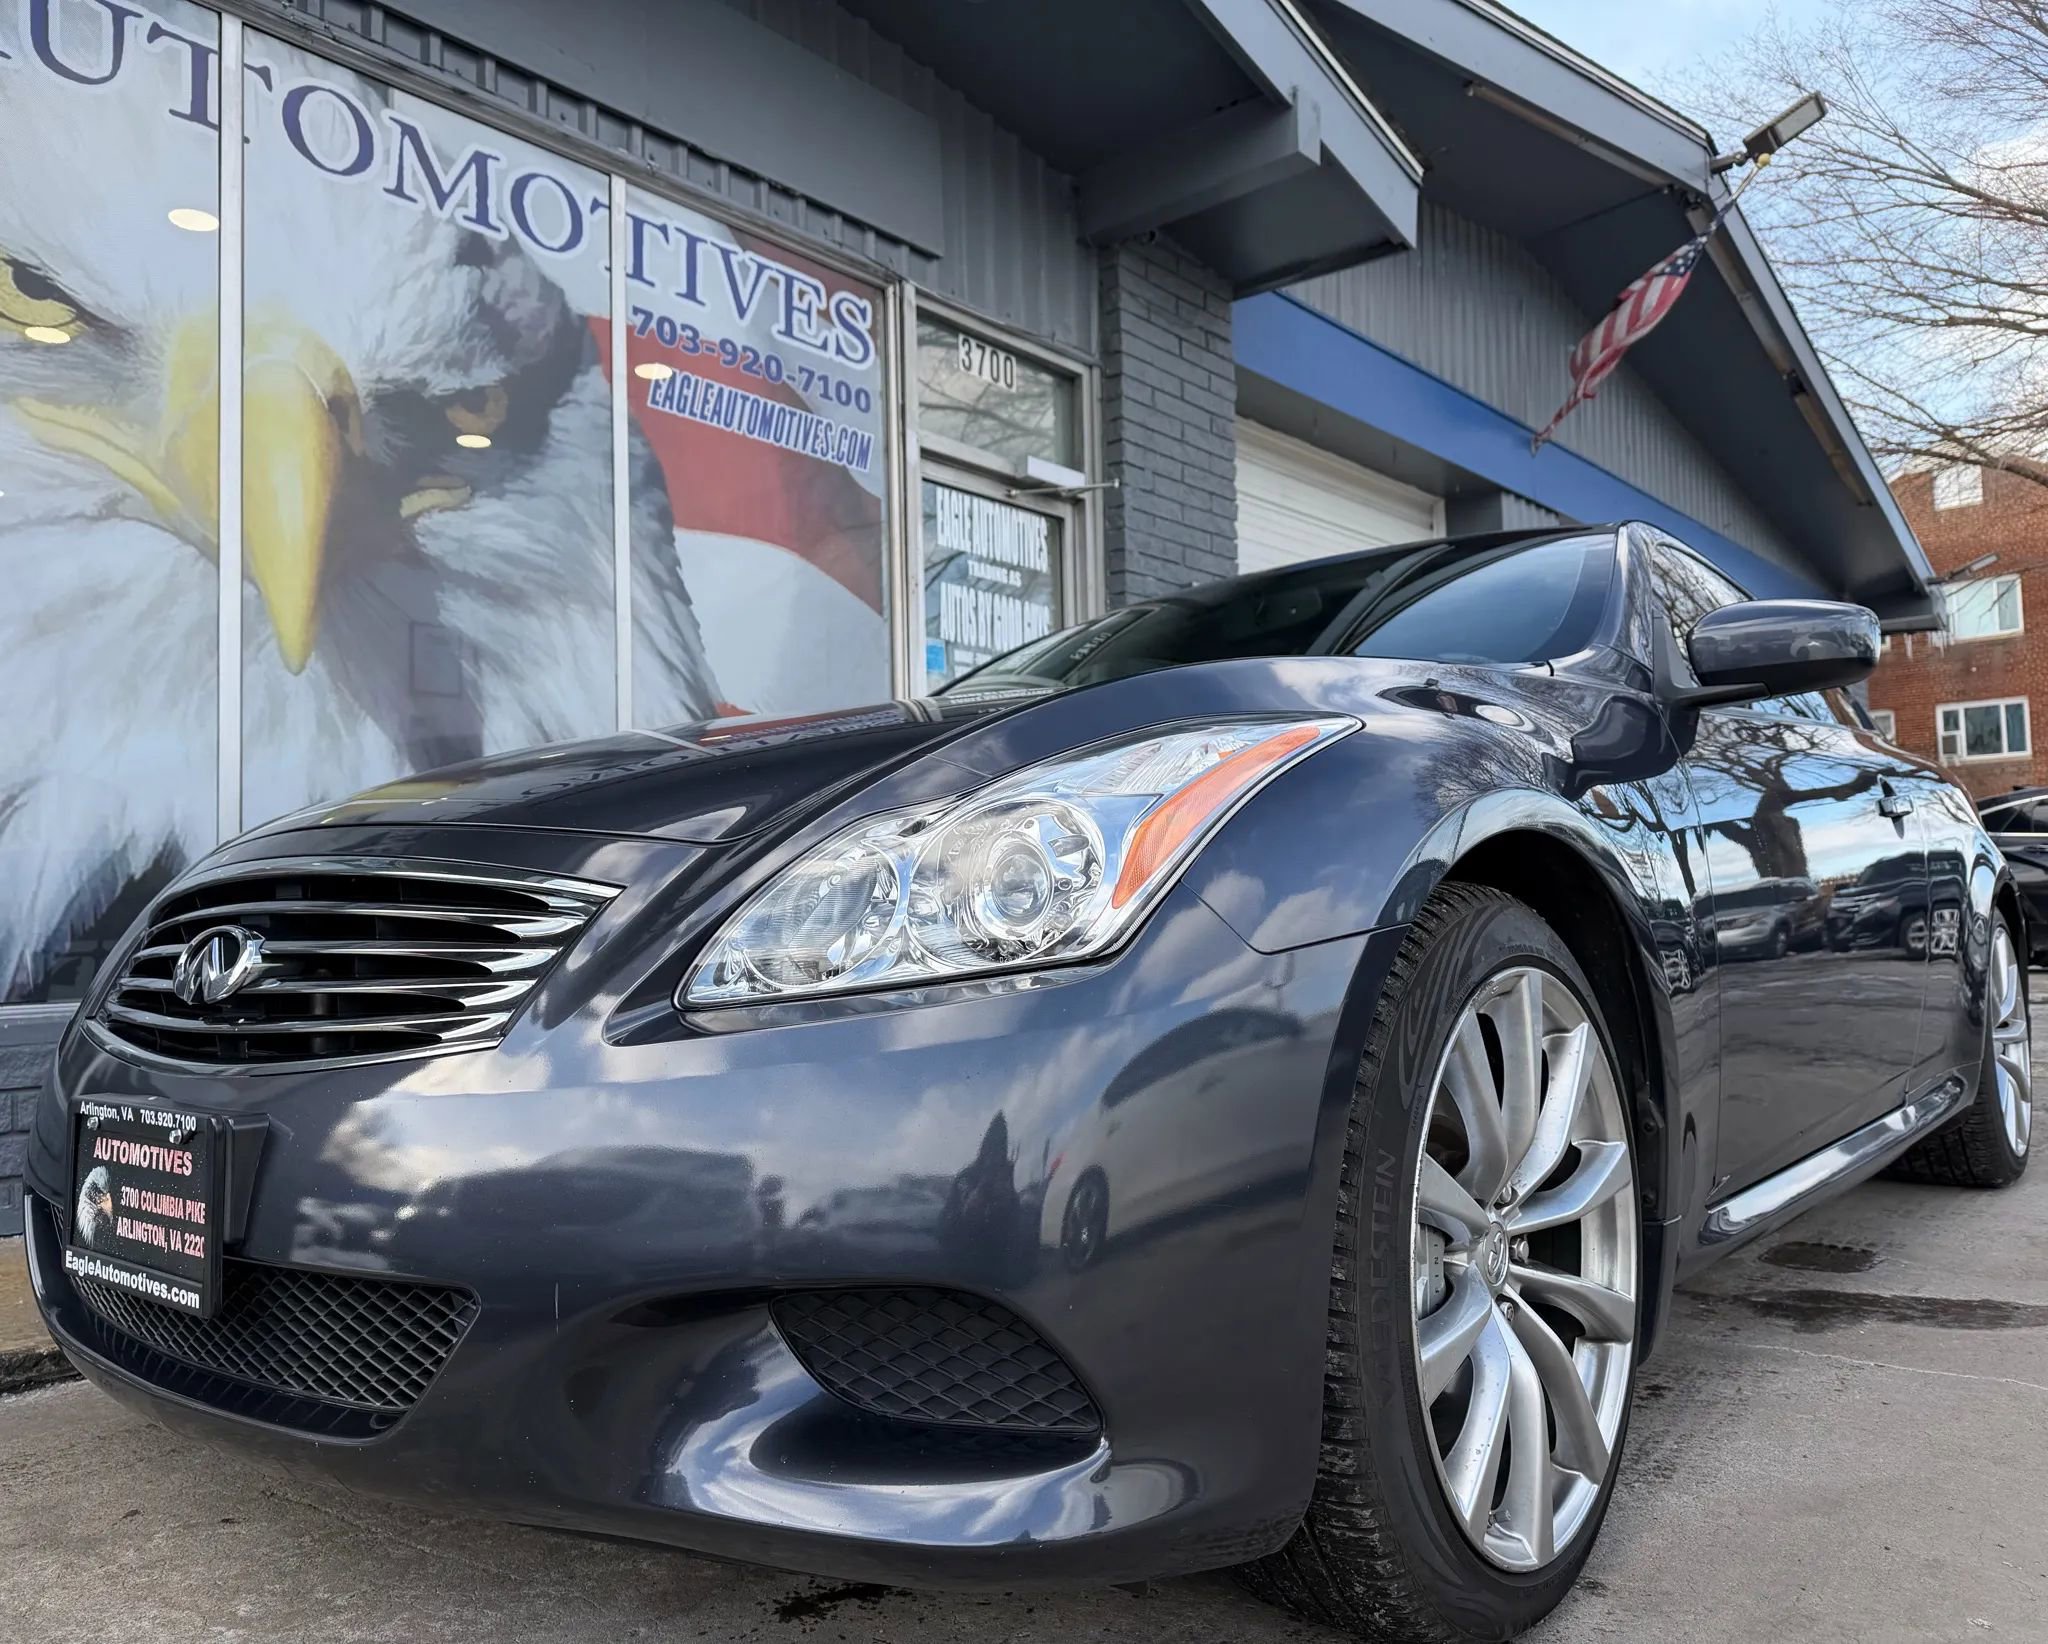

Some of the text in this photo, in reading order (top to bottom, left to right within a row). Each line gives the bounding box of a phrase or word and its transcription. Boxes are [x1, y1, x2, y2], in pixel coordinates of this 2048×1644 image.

[0, 0, 871, 364] UTOMOTIVES
[632, 306, 872, 414] 703-920-7100
[961, 337, 1014, 389] 3700
[648, 369, 872, 471] EAGLEAUTOMOTIVES.COM
[936, 486, 1048, 573] EAGLE AUTOMOTIVES
[966, 560, 1021, 587] TRADING AS
[940, 581, 976, 646] AUTOS
[977, 589, 992, 649] BY
[80, 1101, 196, 1131] Arlington, VA 703.920.7100
[93, 1137, 193, 1176] AUTOMOTIVES
[120, 1186, 206, 1225] 3700 COLUMBIA PIKE
[116, 1216, 168, 1253] ARLINGTON,
[169, 1230, 182, 1252] VA
[65, 1250, 200, 1309] EagleAutomotives.com
